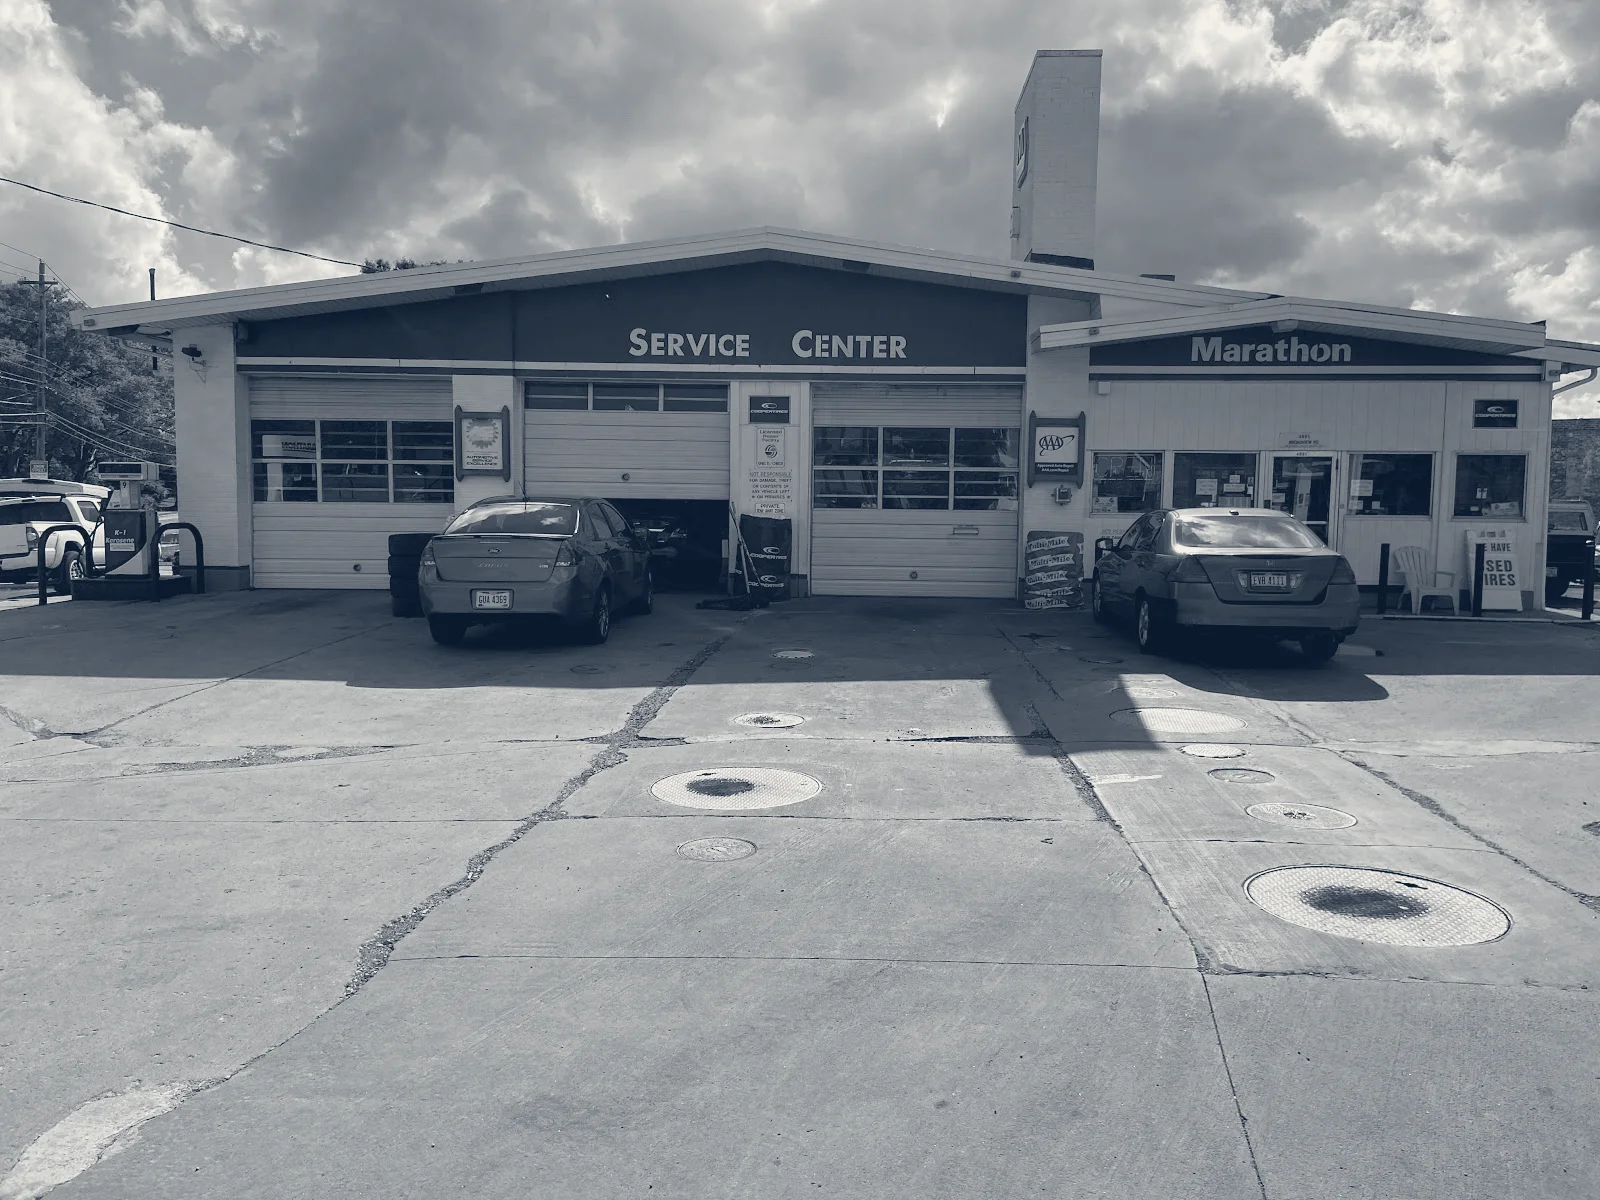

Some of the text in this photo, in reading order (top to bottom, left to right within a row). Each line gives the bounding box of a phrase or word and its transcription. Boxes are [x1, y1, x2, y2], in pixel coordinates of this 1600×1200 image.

[628, 328, 908, 359] SERVICE CENTER
[1190, 336, 1352, 363] Marathon
[1491, 543, 1512, 552] HAVE
[1485, 560, 1513, 572] SED
[1484, 574, 1516, 586] IRES
[478, 596, 490, 604] GUA
